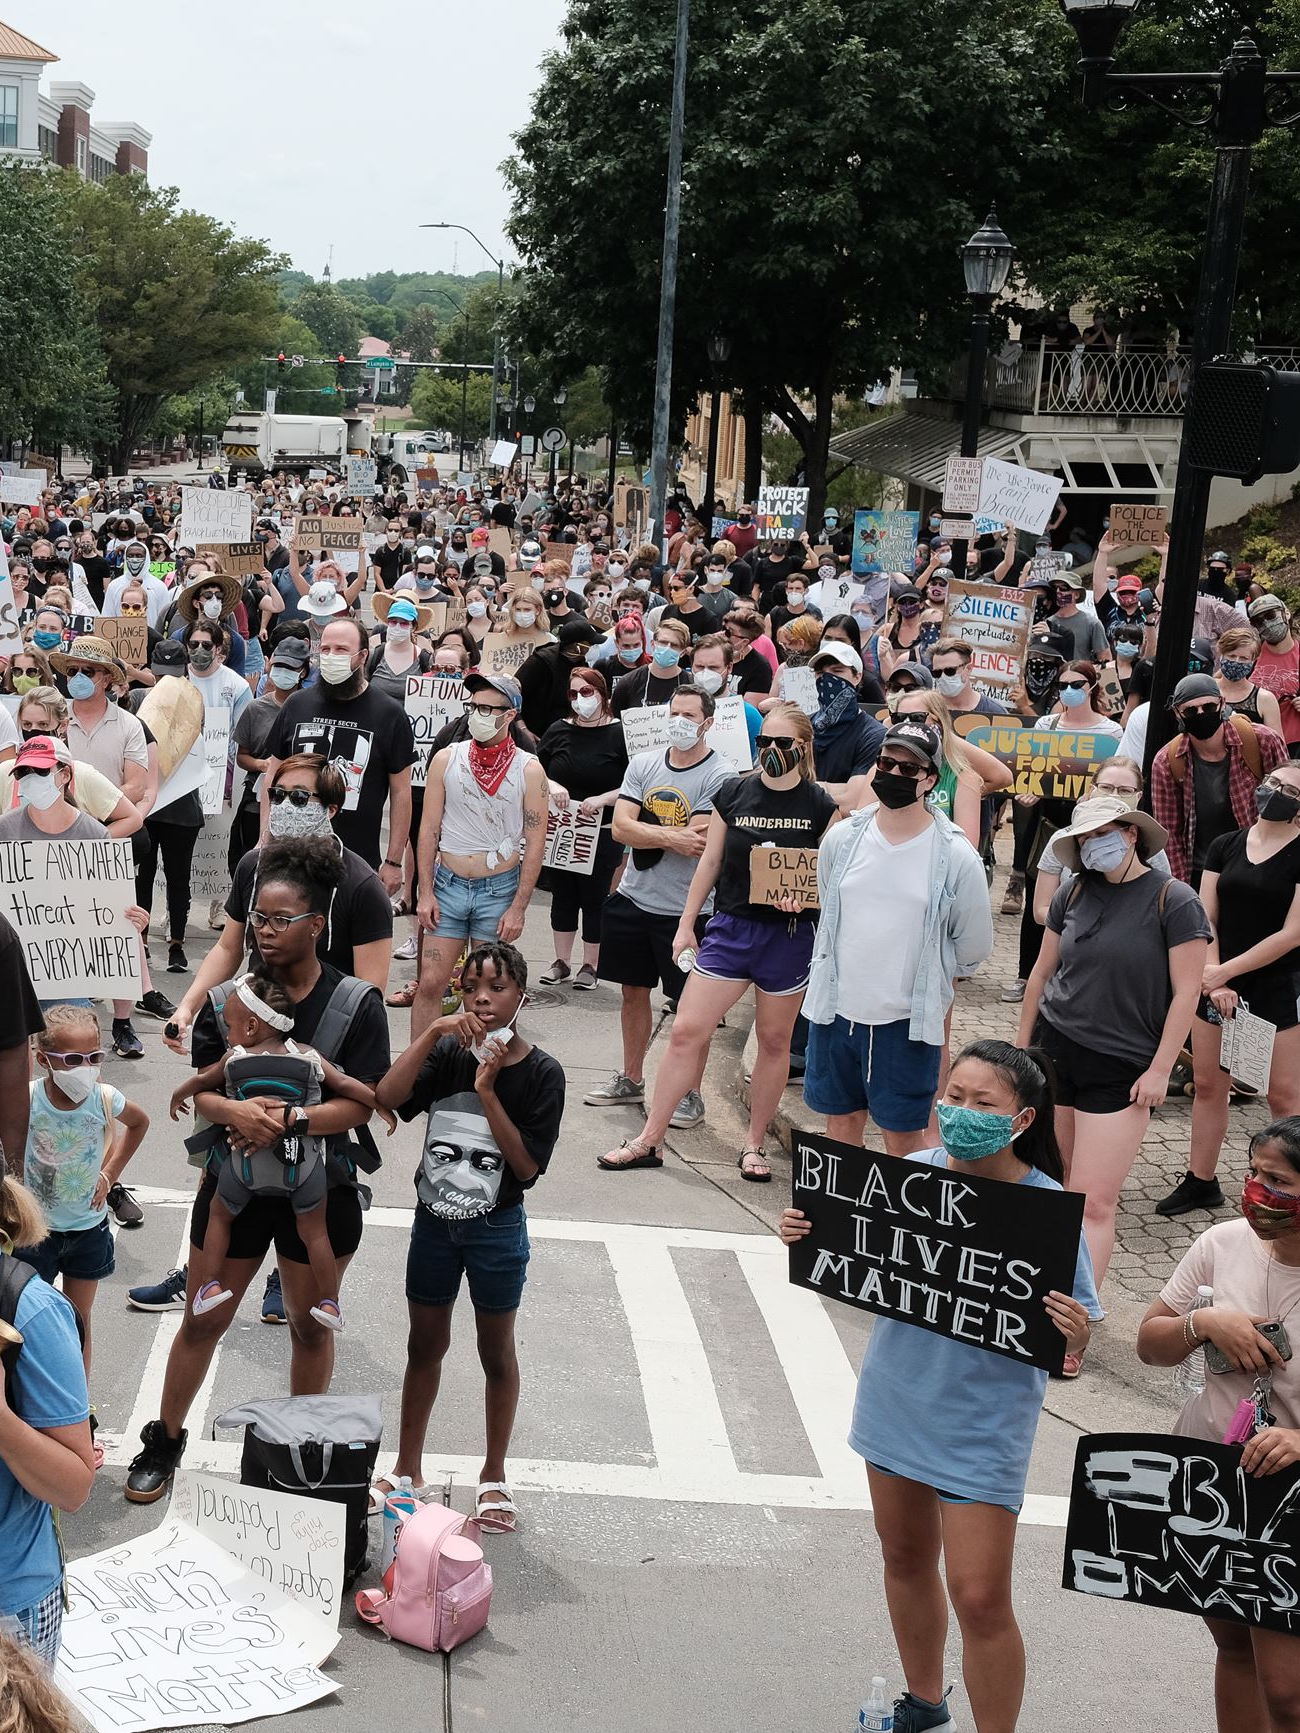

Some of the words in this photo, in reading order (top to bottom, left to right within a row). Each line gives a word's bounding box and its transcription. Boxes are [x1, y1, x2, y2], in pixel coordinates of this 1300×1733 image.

[948, 476, 979, 484] PARKING
[759, 487, 810, 500] PROTECT
[189, 505, 241, 527] POLICE
[757, 501, 805, 516] BLACK
[1114, 506, 1165, 520] POLICE
[301, 521, 320, 533] NO
[890, 525, 913, 538] LOVE
[1127, 520, 1145, 529] THE
[301, 536, 315, 545] NO
[323, 533, 359, 546] PEACE
[756, 528, 795, 539] LIVES
[1112, 529, 1160, 542] POLICE
[231, 545, 261, 556] LIVES
[882, 561, 912, 571] UNITE
[1000, 589, 1025, 601] 1312
[960, 598, 1020, 621] SILENCE
[961, 623, 1017, 644] perpetuates
[110, 639, 145, 660] NOW
[493, 642, 528, 657] BLACK
[428, 703, 446, 716] the
[312, 717, 338, 726] STREET
[338, 720, 358, 728] SECTS
[978, 730, 1096, 759] JUSTICE
[1016, 755, 1063, 773] FOR
[556, 829, 574, 862] STAND
[569, 833, 594, 864] WITH
[46, 840, 135, 881] ANYWHERE
[768, 851, 818, 870] BLAC
[192, 882, 232, 895] DANGE
[780, 874, 818, 888] LIVE
[766, 889, 819, 904] MATTE
[10, 890, 76, 926] threat
[88, 897, 114, 926] to
[27, 936, 140, 982] EVERYWHERE
[795, 1143, 978, 1228] BLACK
[438, 1187, 445, 1197] I
[445, 1191, 490, 1209] CAN'T
[850, 1213, 1042, 1301] LIVES
[806, 1248, 1034, 1357] MATTER
